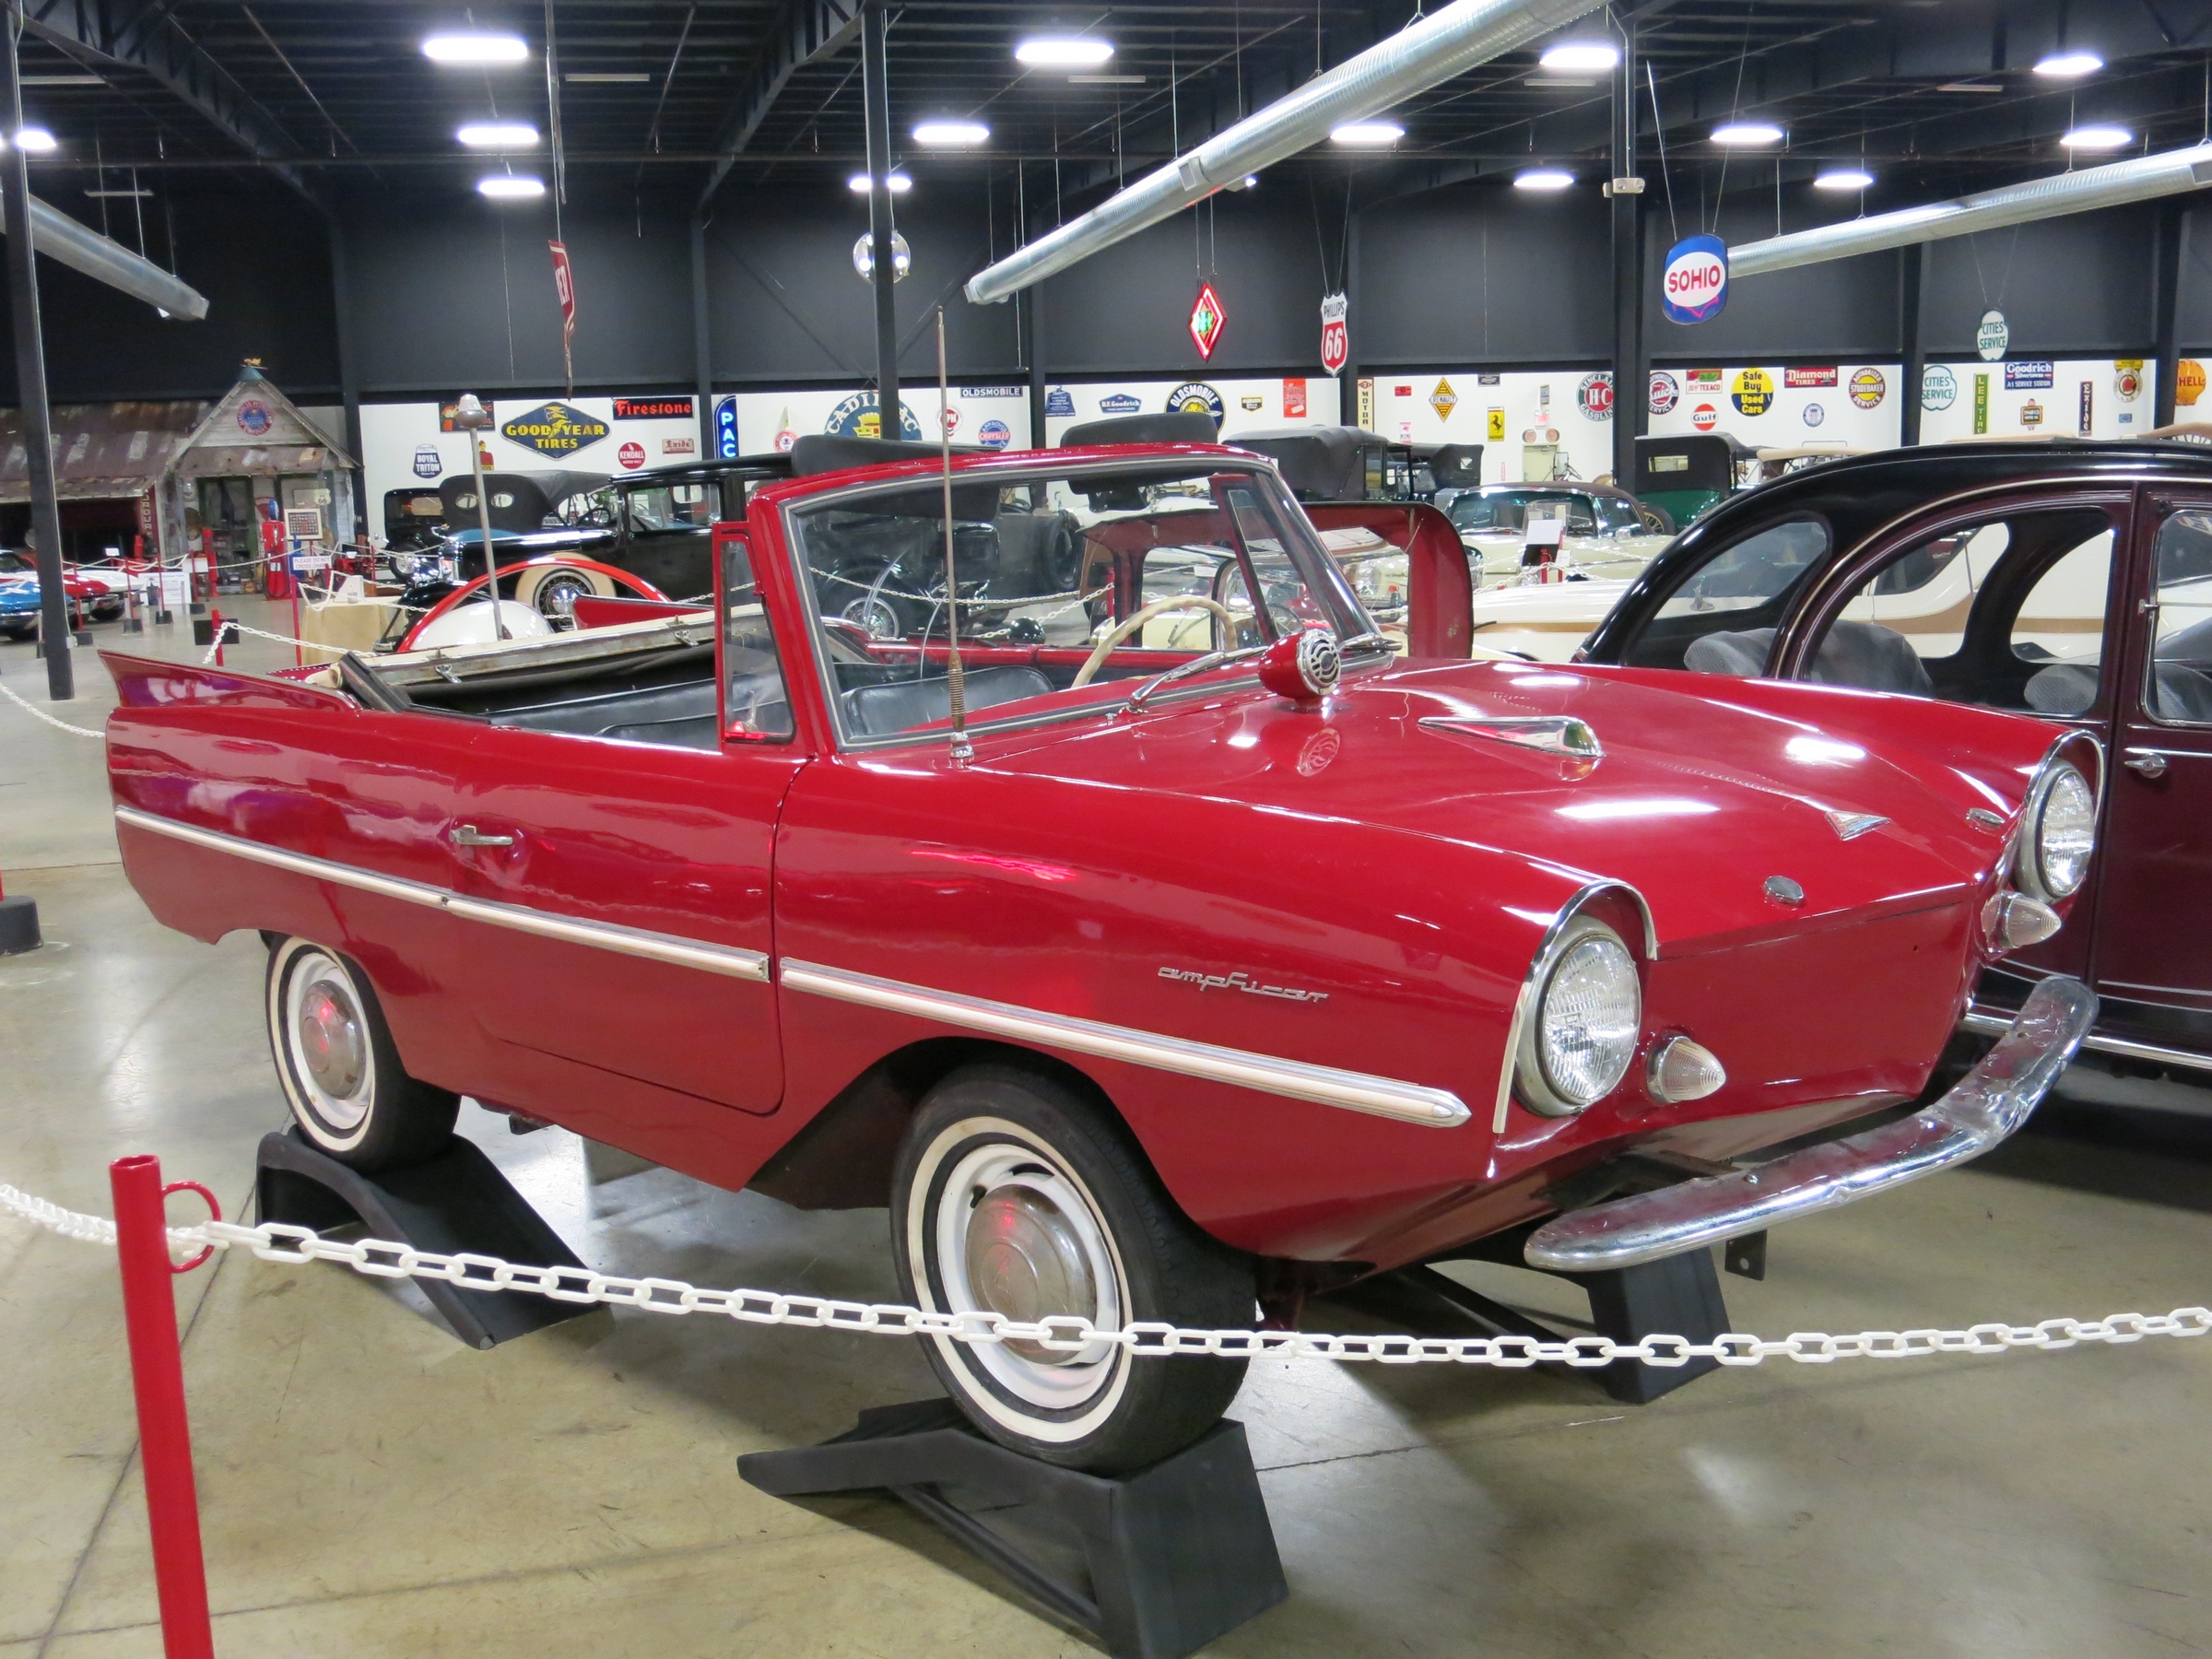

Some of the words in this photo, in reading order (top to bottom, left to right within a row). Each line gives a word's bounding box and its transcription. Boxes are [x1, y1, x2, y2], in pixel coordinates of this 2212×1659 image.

[1668, 265, 1721, 293] SOHIO
[1324, 300, 1345, 319] PHILLIPS
[1982, 322, 2004, 335] CITIES
[1324, 327, 1343, 360] 66
[1979, 335, 2006, 350] SERVICE
[2006, 363, 2053, 373] Goodrich
[1743, 371, 1762, 381] Safe
[1785, 370, 1836, 381] Diamond
[2176, 376, 2205, 386] HELL
[1580, 374, 1613, 391] SINCLAI
[1924, 376, 1950, 387] CITIES
[962, 387, 1020, 397] OLDSMOBILE
[1744, 382, 1761, 393] Buy
[1850, 383, 1884, 394] STUDEBAKER
[1171, 384, 1219, 407] OLDSMOBILE
[1432, 395, 1456, 404] RENAULT
[1741, 394, 1764, 404] Used
[1853, 395, 1881, 407] SERVICE
[614, 399, 692, 417] Firestone
[1361, 391, 1370, 425] MOTOR
[1580, 403, 1613, 419] GASOLIN
[1741, 405, 1763, 414] Cars
[506, 424, 606, 436] GOODYEAR
[535, 438, 579, 449] TIRES
[666, 440, 690, 448] Exide
[417, 454, 439, 464] ROYAL
[619, 451, 644, 459] KENDALL
[416, 463, 441, 472] TRITON
